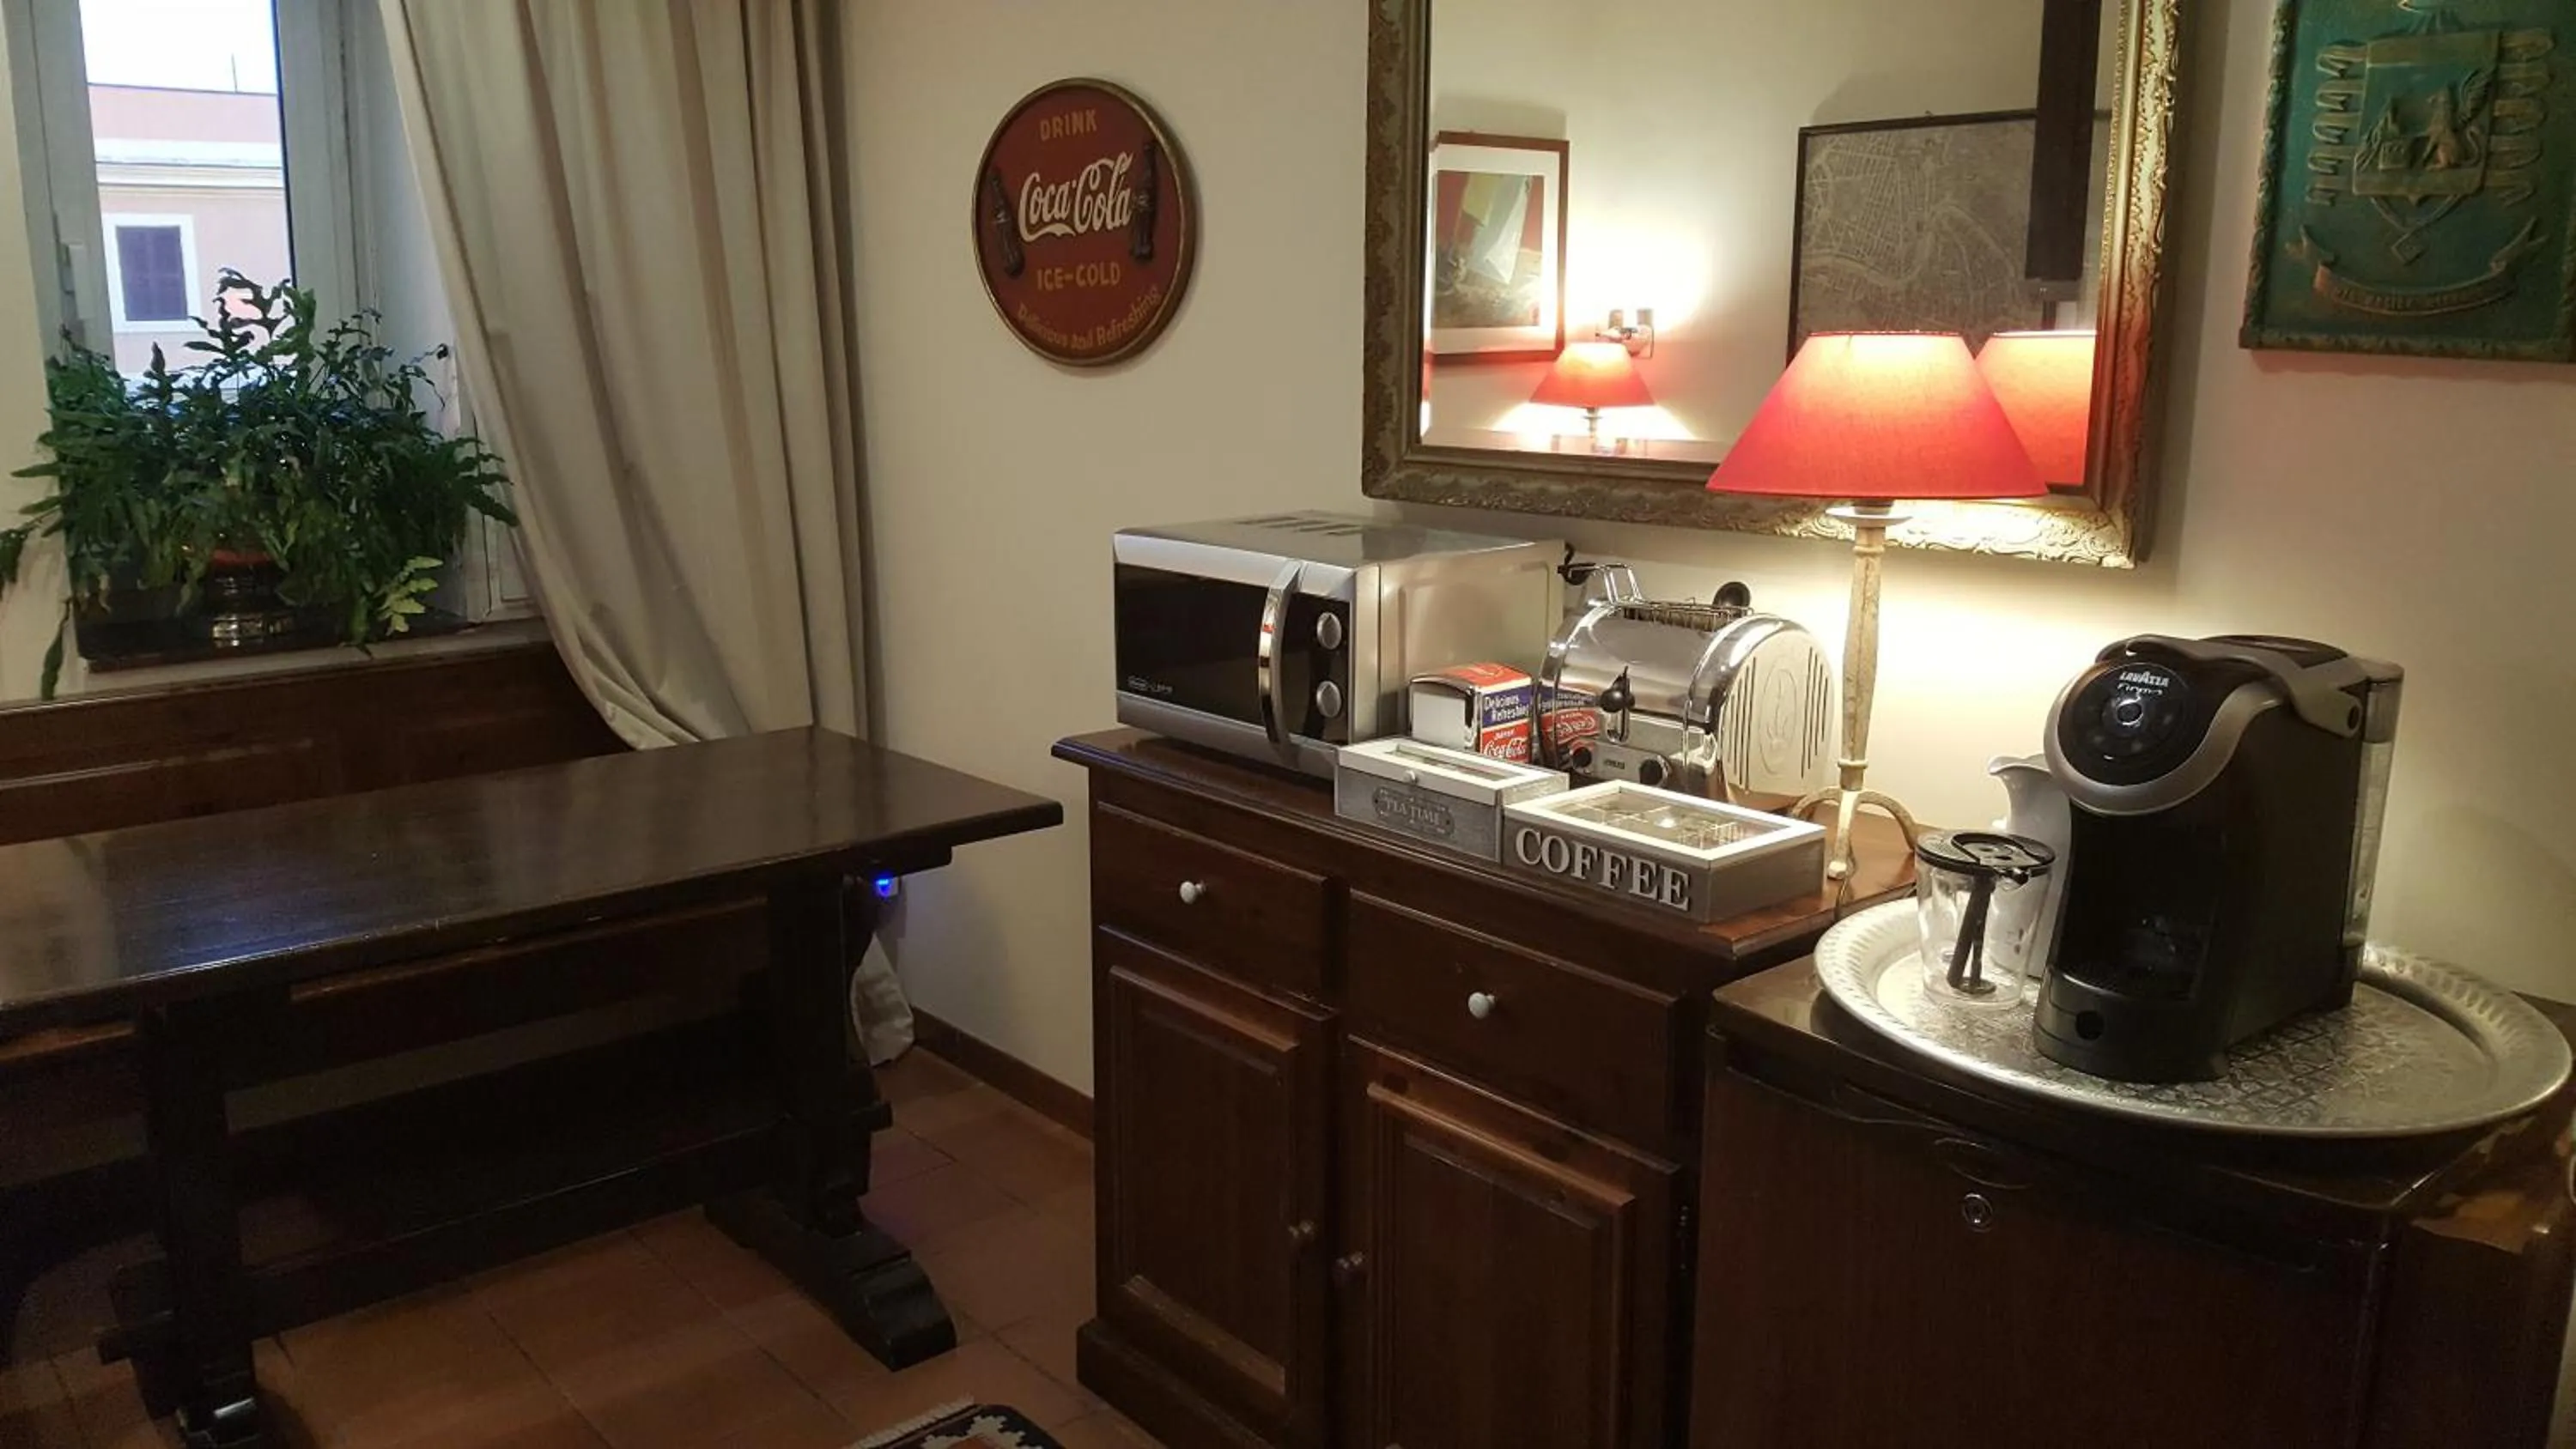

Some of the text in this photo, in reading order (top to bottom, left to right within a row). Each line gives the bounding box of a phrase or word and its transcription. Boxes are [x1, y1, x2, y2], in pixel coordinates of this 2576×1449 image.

[1039, 109, 1097, 142] DRINK
[1036, 262, 1121, 290] ICE-COLD
[1017, 302, 1068, 347] Delicious
[1097, 286, 1161, 345] Refreshing
[2119, 671, 2170, 688] LAVAZZA
[1515, 827, 1689, 911] COFFEE
